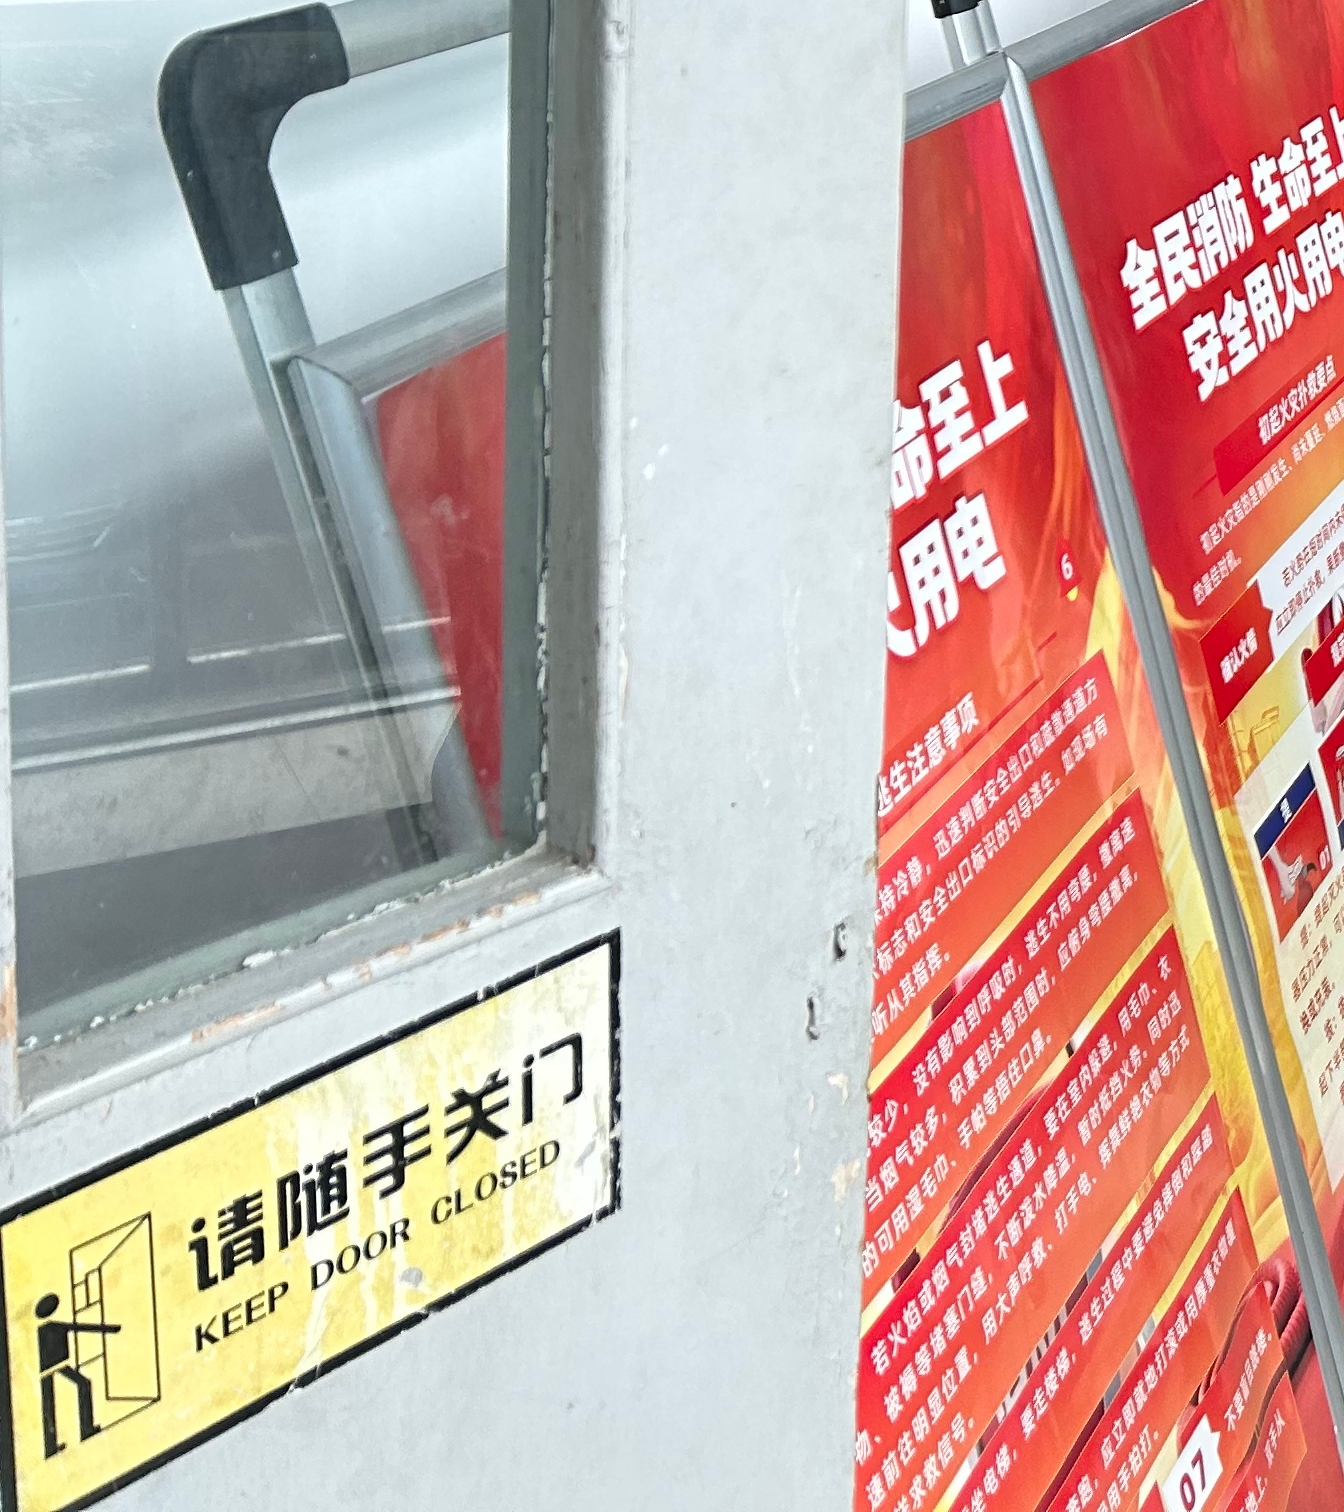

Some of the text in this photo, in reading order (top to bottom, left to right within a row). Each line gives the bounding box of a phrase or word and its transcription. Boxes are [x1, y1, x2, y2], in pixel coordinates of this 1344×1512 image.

[1114, 170, 1256, 333] 全民消防
[1255, 353, 1337, 446] 初起火灾扑救要点
[1059, 554, 1073, 581] 6
[1218, 623, 1259, 686] 确认火情
[868, 712, 1109, 987] 标志和安全出口标识的引导逃生。如现场有
[1316, 841, 1332, 875] 01
[860, 813, 1136, 1160] 较少，没有影响到呼吸时，逃生不用弯腰，撤离速
[869, 932, 952, 1044] 听从其指挥。
[187, 1031, 584, 1292] 请随手关门
[859, 1016, 1052, 1281] 的可用湿毛巾、手帕等捂住口鼻。
[194, 1139, 561, 1354] KEEP DOOR CLOSED
[961, 1120, 1213, 1512] 坐电梯，要走楼梯，逃生过程中要避免摔倒和踩踏
[1179, 1447, 1207, 1512] 07
